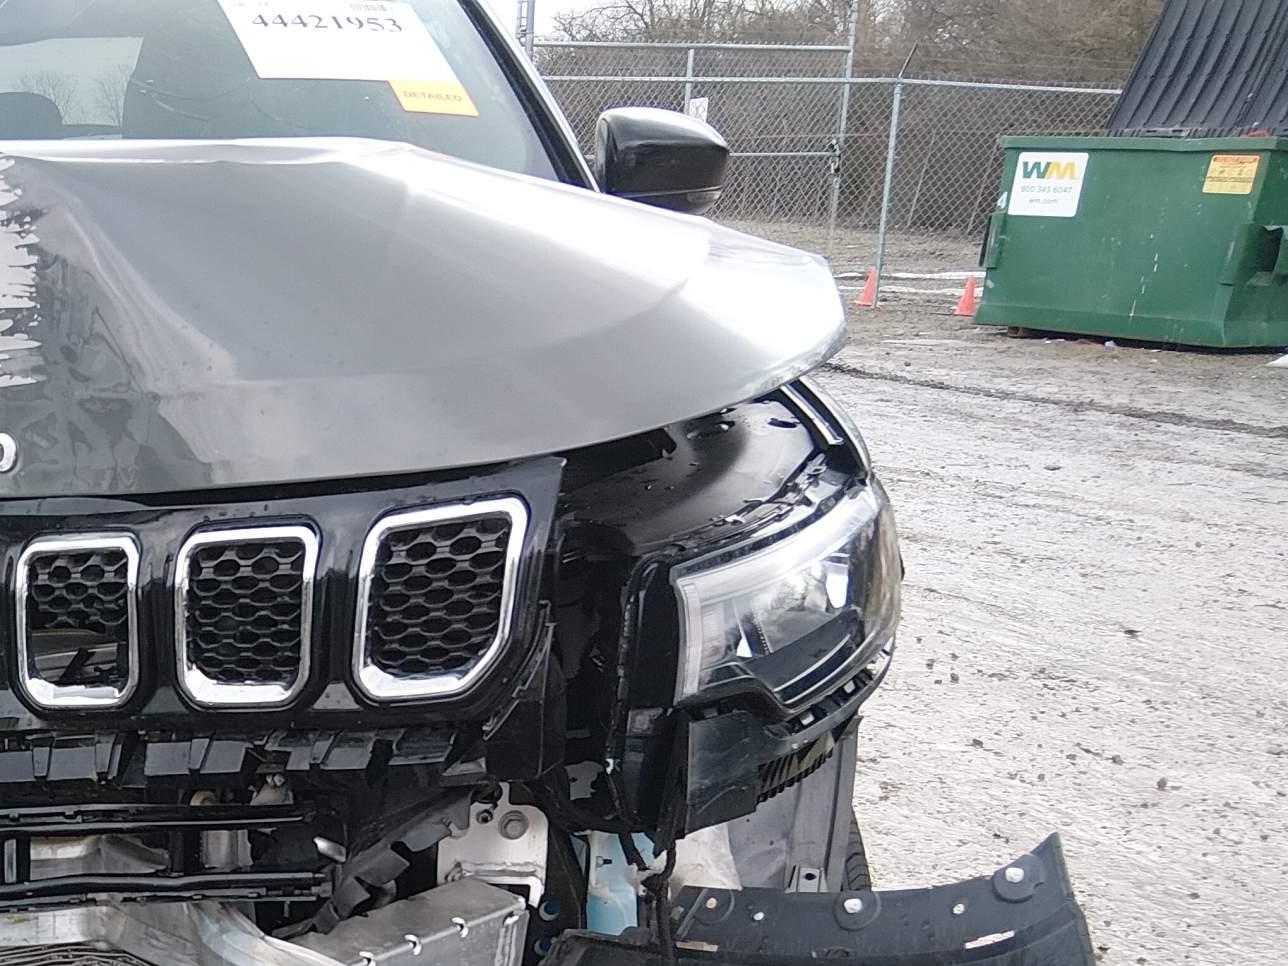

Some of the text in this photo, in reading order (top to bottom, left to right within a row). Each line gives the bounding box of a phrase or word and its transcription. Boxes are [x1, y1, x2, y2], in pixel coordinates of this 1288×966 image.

[252, 13, 403, 33] 44421953
[402, 90, 463, 102] DETAILED
[1022, 161, 1078, 180] WM
